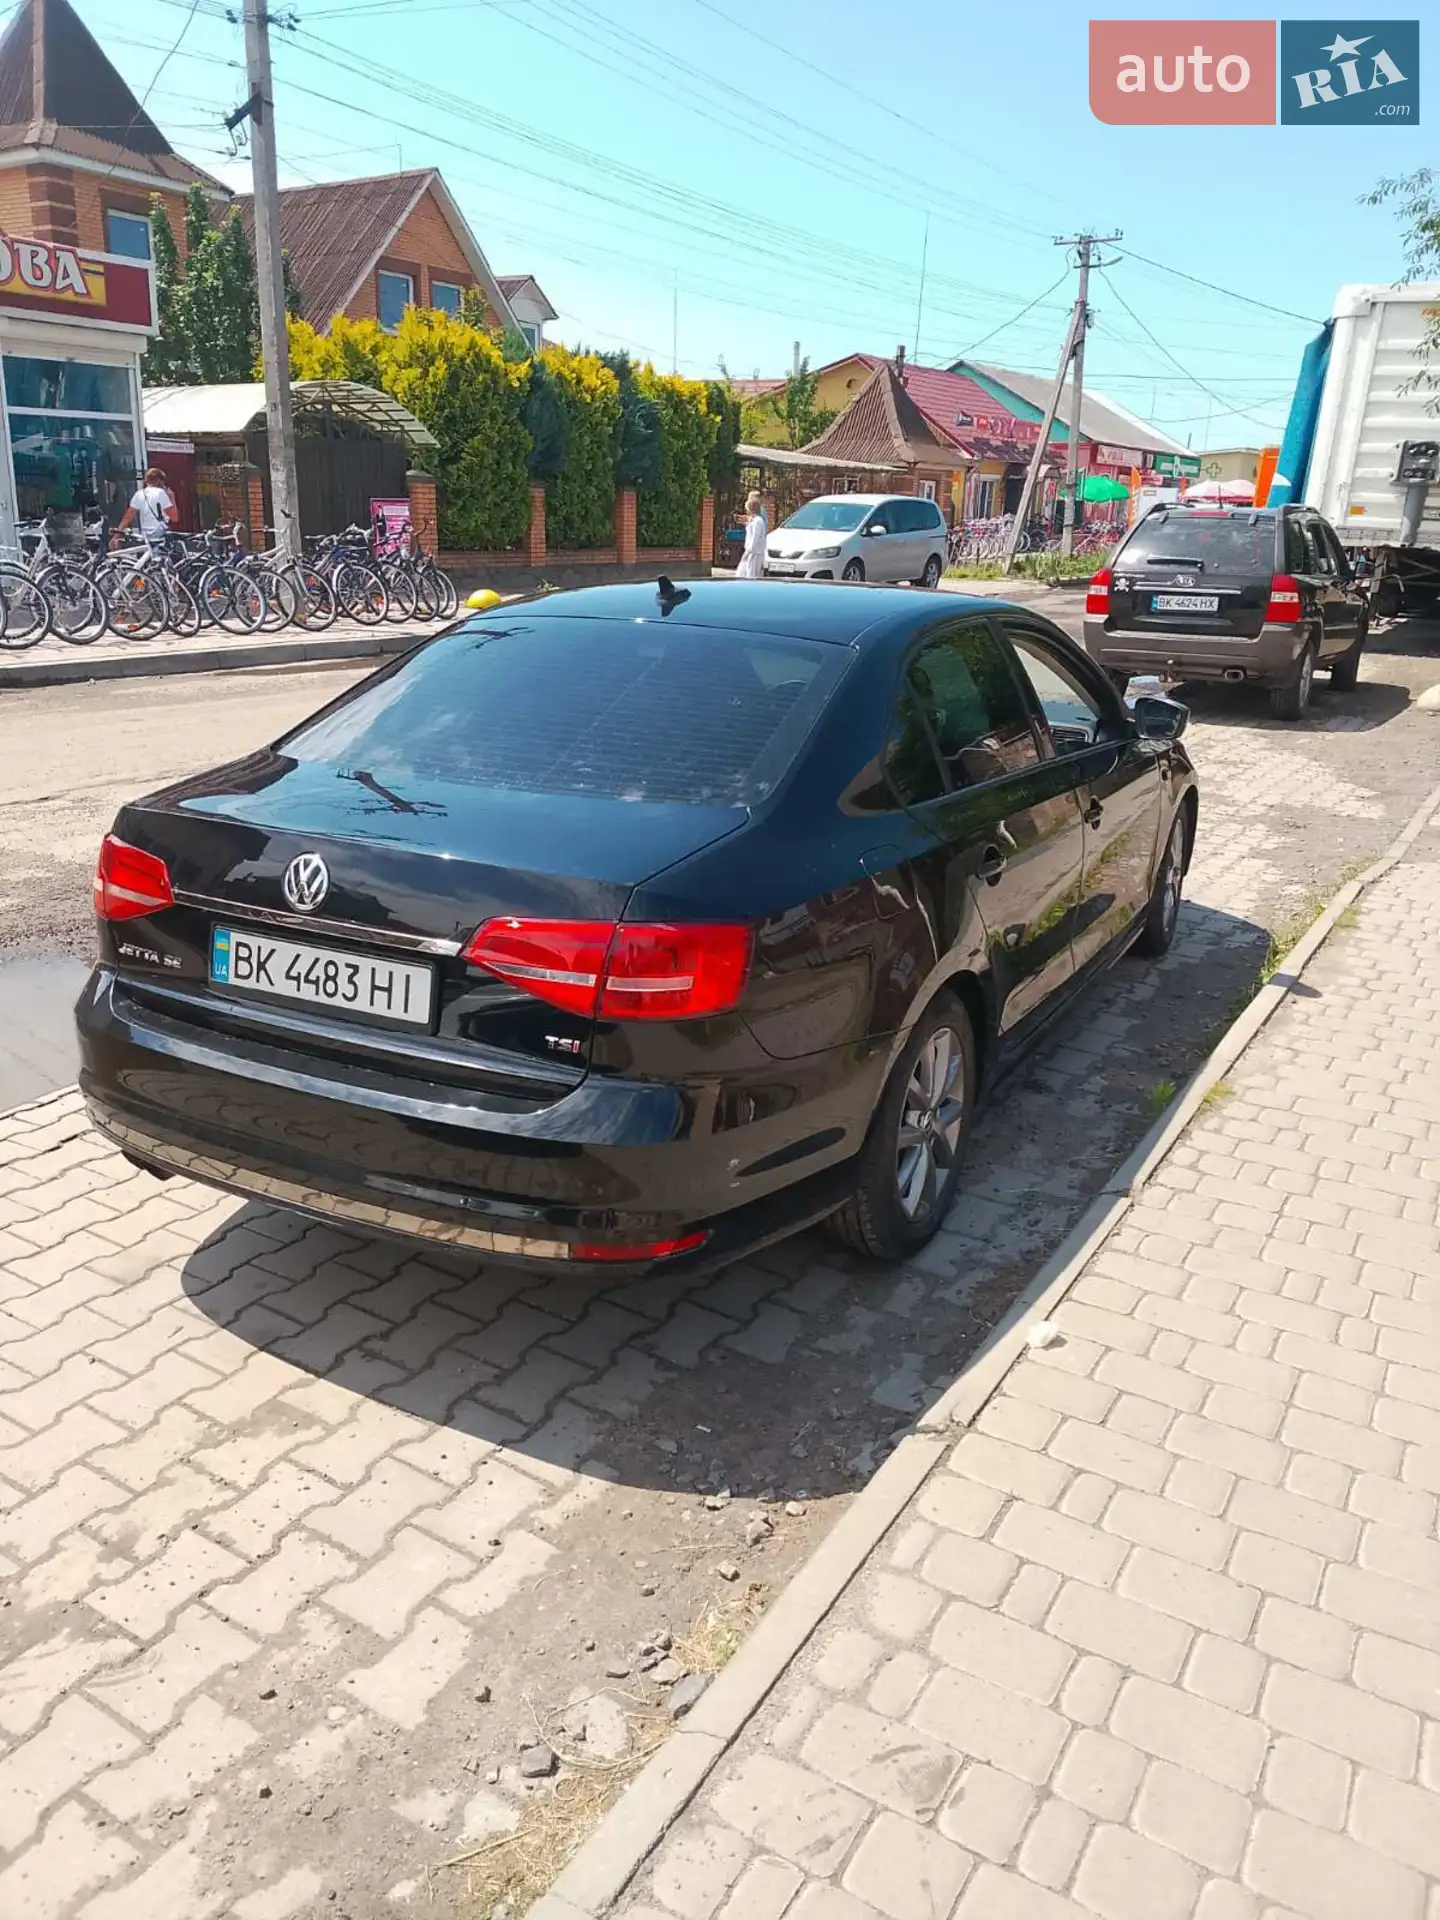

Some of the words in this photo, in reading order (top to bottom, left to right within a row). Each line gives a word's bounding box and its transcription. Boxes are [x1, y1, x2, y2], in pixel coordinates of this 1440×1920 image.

[1159, 597, 1172, 608] BK
[1200, 598, 1216, 609] HX
[118, 942, 160, 963] JETTA
[163, 954, 182, 969] SE
[215, 961, 228, 977] UA
[234, 941, 276, 986] BK
[285, 953, 360, 1002] 4483
[369, 967, 411, 1014] HI
[544, 1034, 581, 1053] TSI
